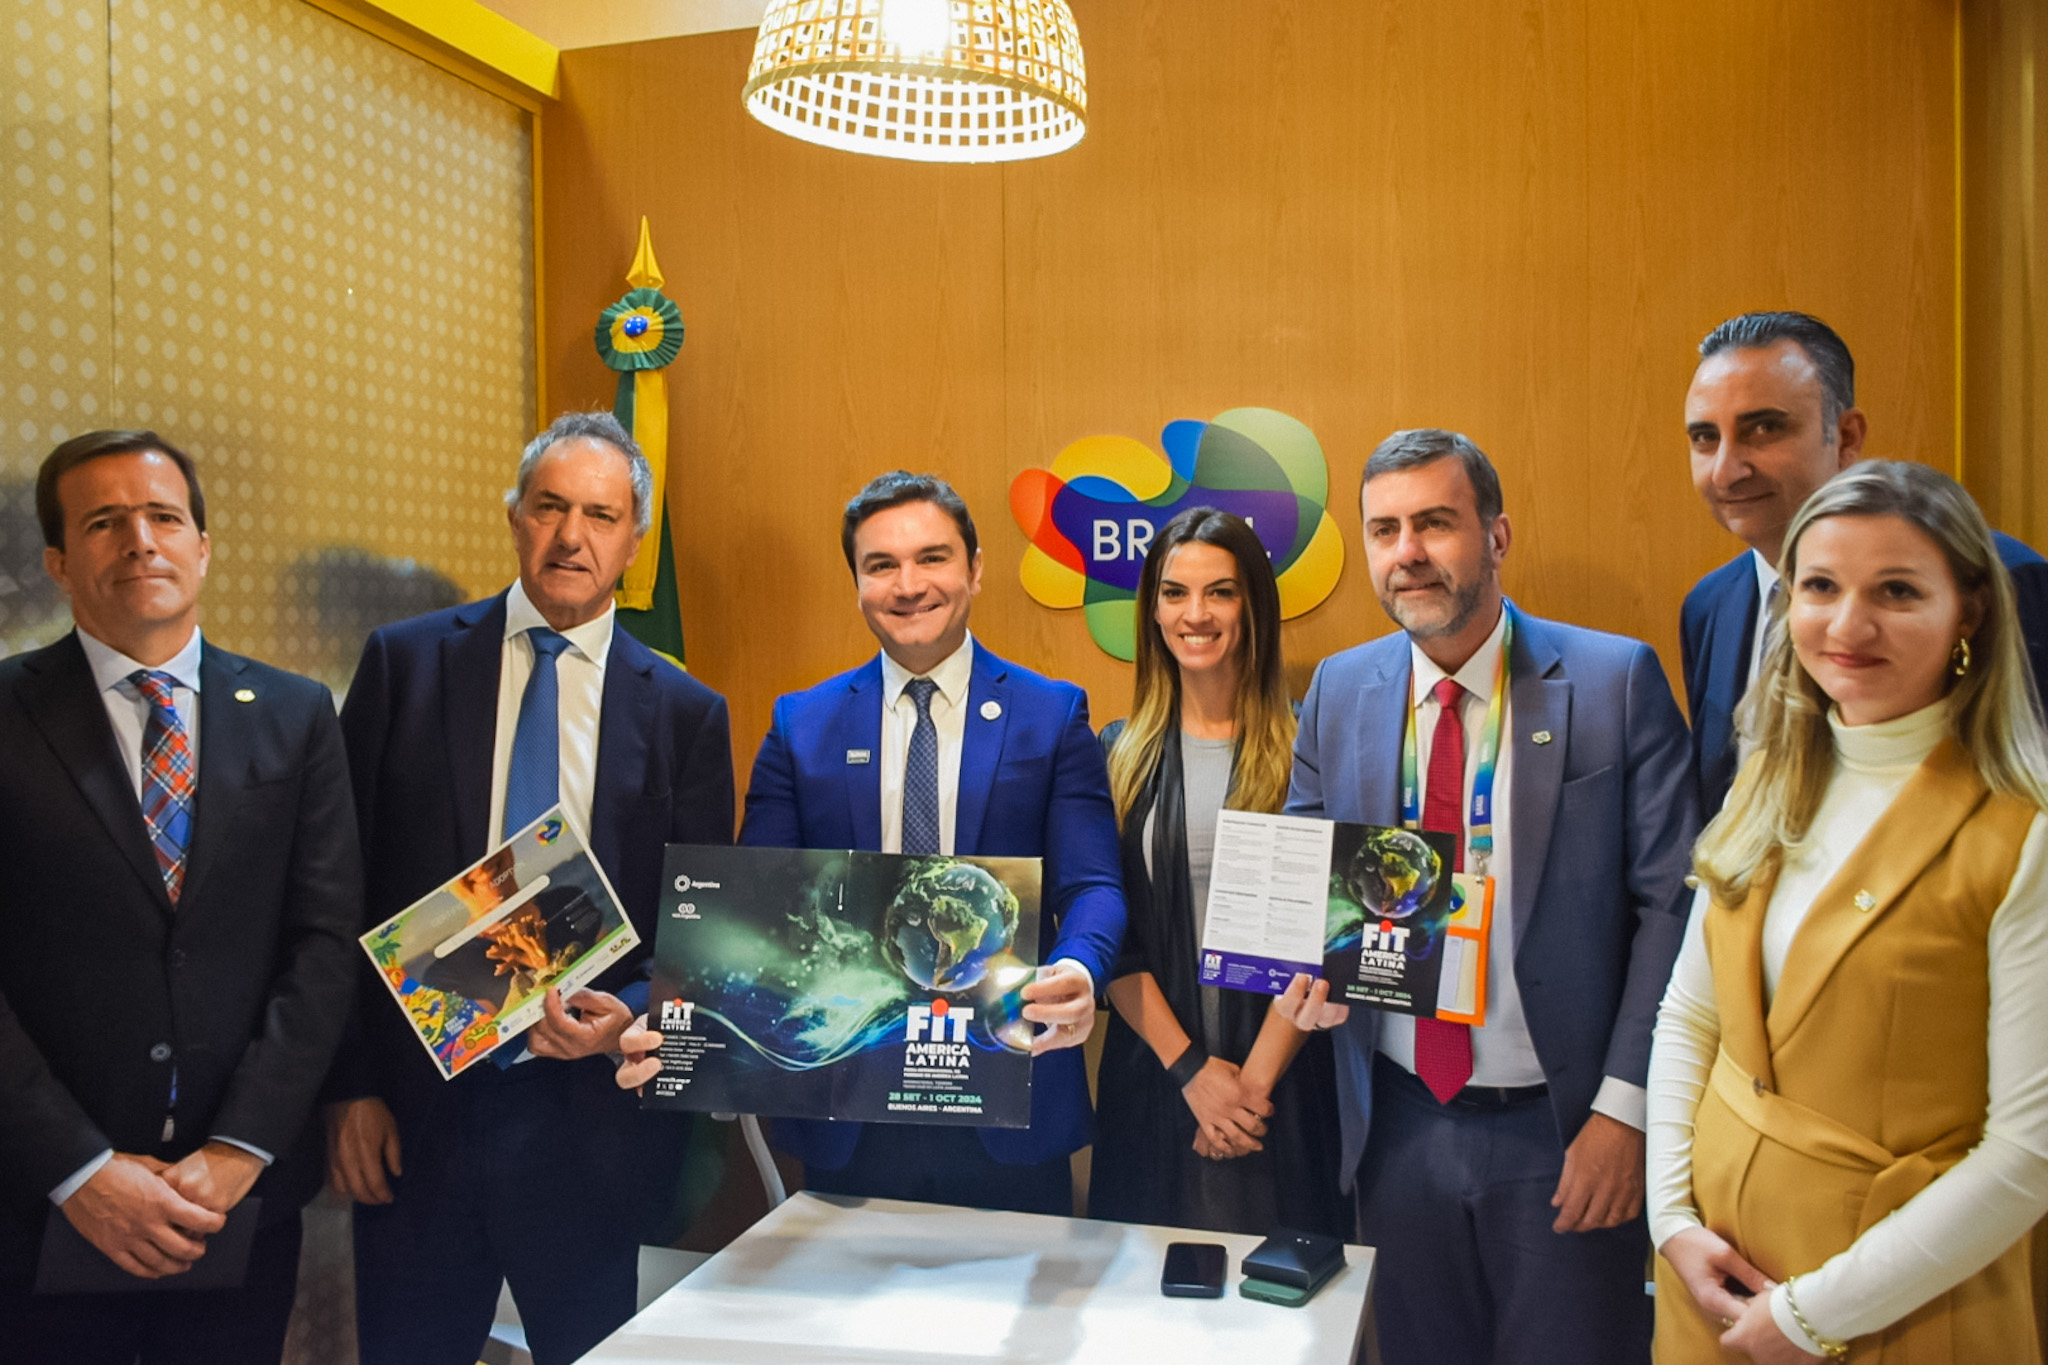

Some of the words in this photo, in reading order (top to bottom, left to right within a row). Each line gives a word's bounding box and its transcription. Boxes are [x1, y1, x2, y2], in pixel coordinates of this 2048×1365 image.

[1361, 956, 1405, 970] LATINA
[905, 1043, 971, 1056] AMERICA
[905, 1054, 970, 1068] LATINA
[888, 1092, 901, 1101] 28
[903, 1092, 921, 1102] SET
[929, 1094, 934, 1102] 1
[935, 1094, 956, 1103] OCT
[958, 1095, 982, 1104] 2024
[887, 1103, 916, 1112] BUENOS
[917, 1104, 938, 1112] AIRES
[942, 1106, 983, 1114] ARGENTINA
